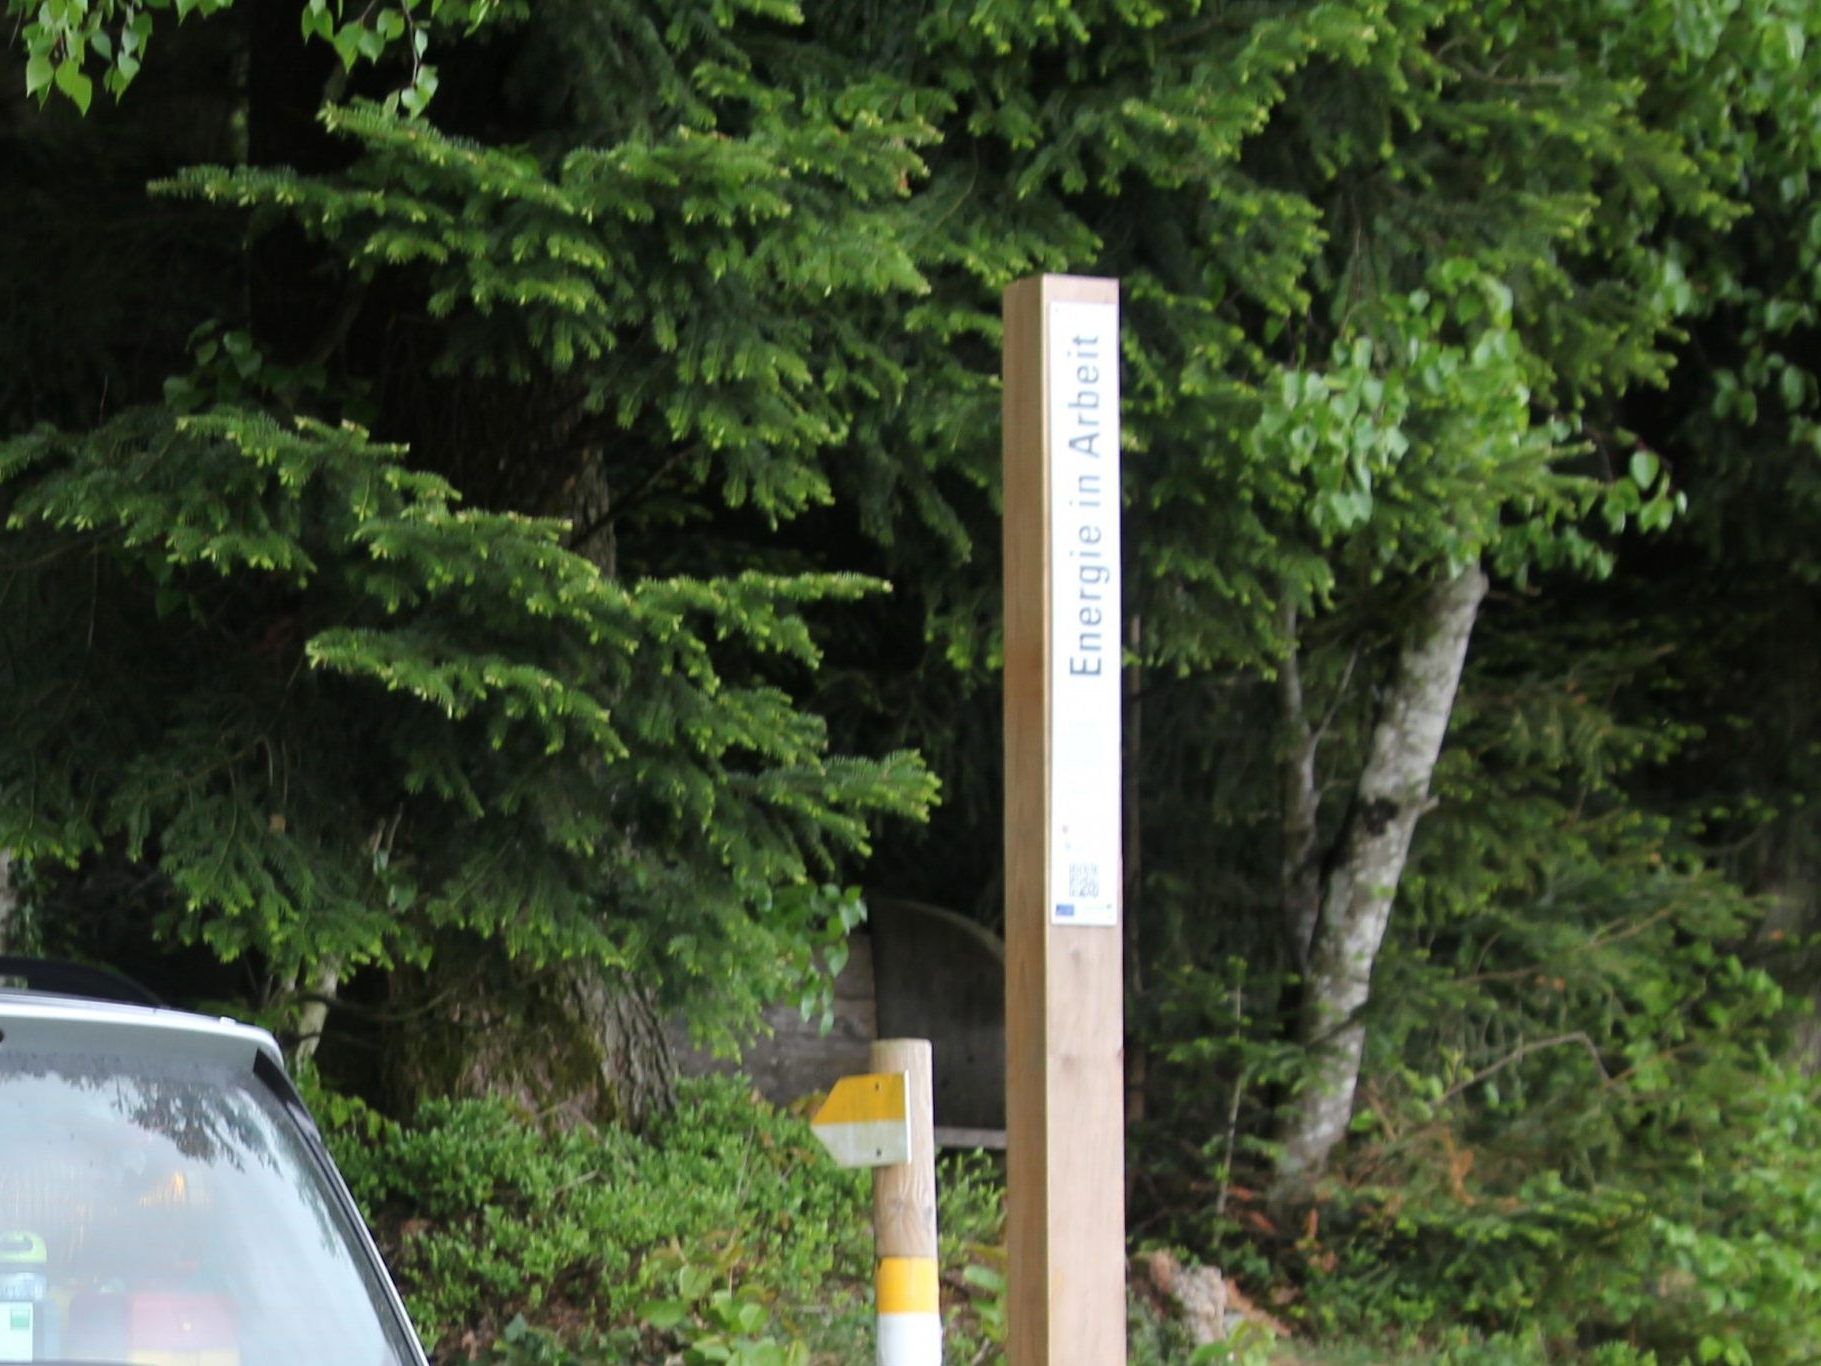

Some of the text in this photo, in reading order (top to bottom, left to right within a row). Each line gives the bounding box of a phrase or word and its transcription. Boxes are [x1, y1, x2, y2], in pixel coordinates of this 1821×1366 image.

[1067, 334, 1111, 677] Energie in Arbeit
